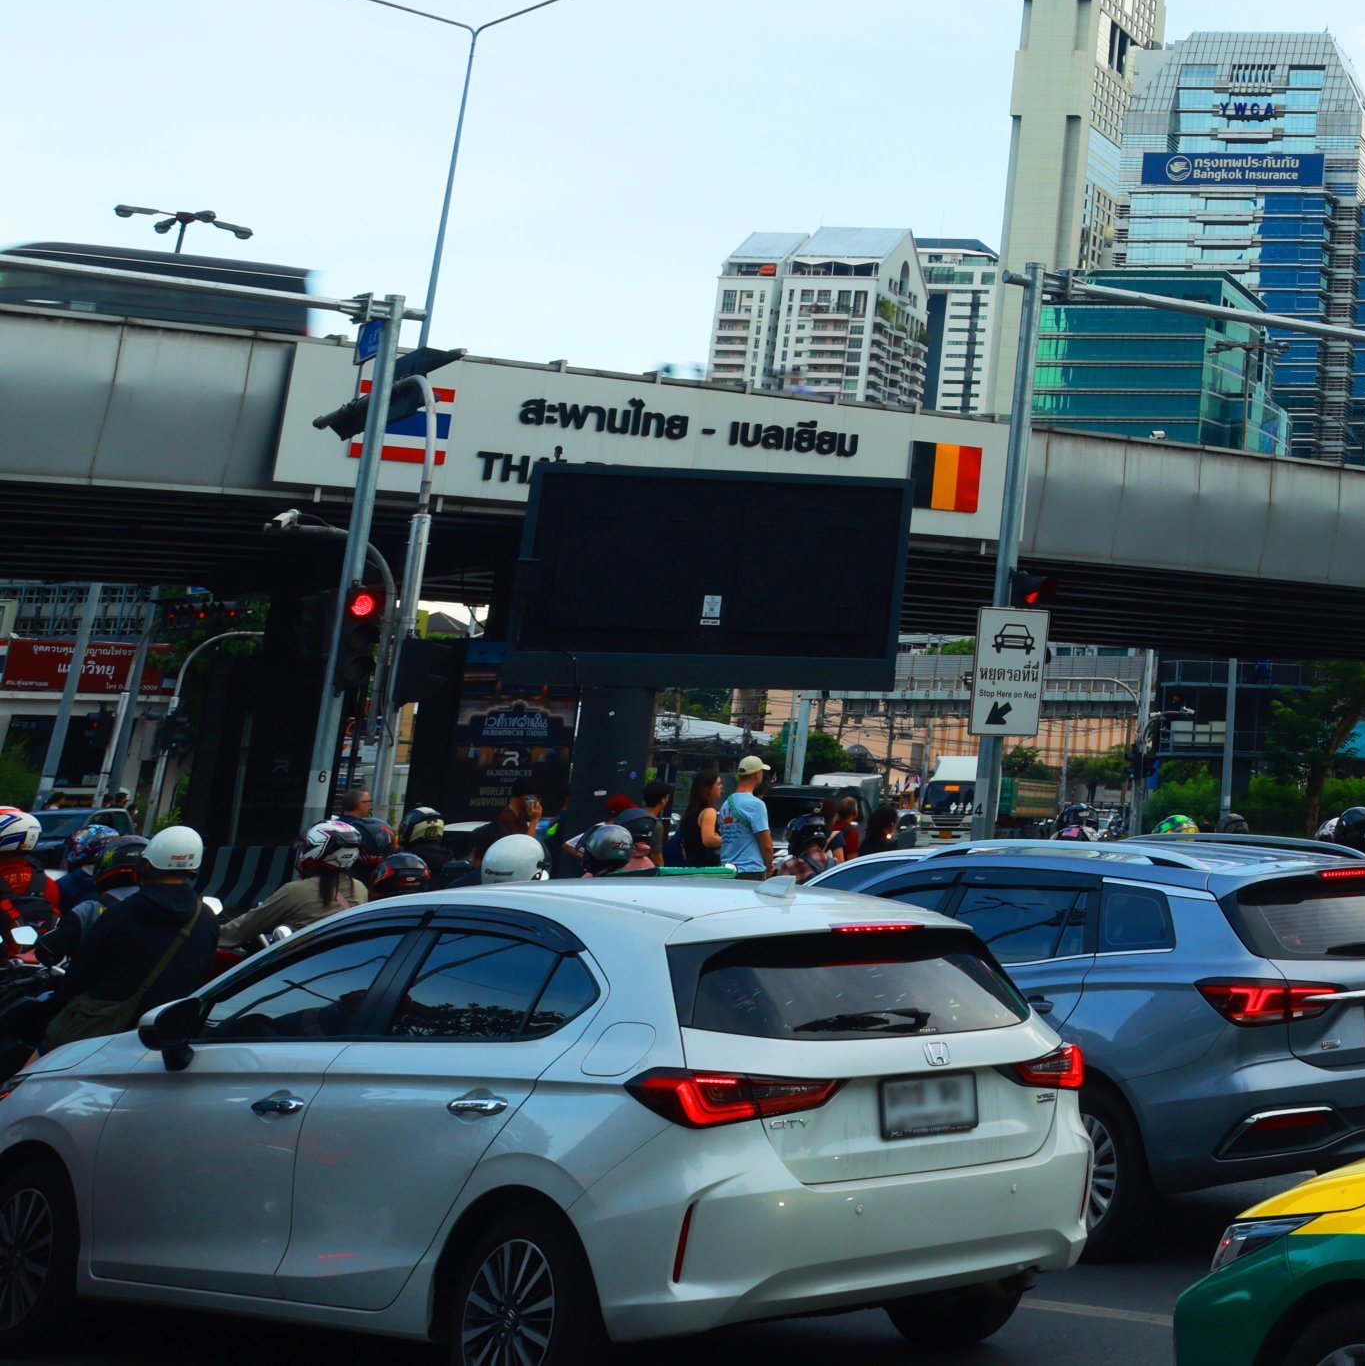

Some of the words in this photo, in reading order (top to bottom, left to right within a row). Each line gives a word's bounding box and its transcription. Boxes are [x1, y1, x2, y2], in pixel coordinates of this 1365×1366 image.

[1220, 102, 1274, 116] YWCA
[1194, 155, 1300, 171] กรุงเทพประกันภัย
[1193, 168, 1242, 182] Bangkok
[1245, 168, 1298, 180] Insurance
[519, 397, 690, 441] สะพานไทย
[728, 420, 860, 459] เบลเยียม
[979, 660, 1040, 686] หยุดรอที่นี่
[979, 689, 995, 699] Stop
[996, 690, 1012, 698] Here
[1013, 691, 1022, 699] on
[1023, 691, 1037, 699] Red
[318, 770, 327, 784] 6
[974, 802, 983, 817] 4
[768, 1118, 810, 1131] CITY
